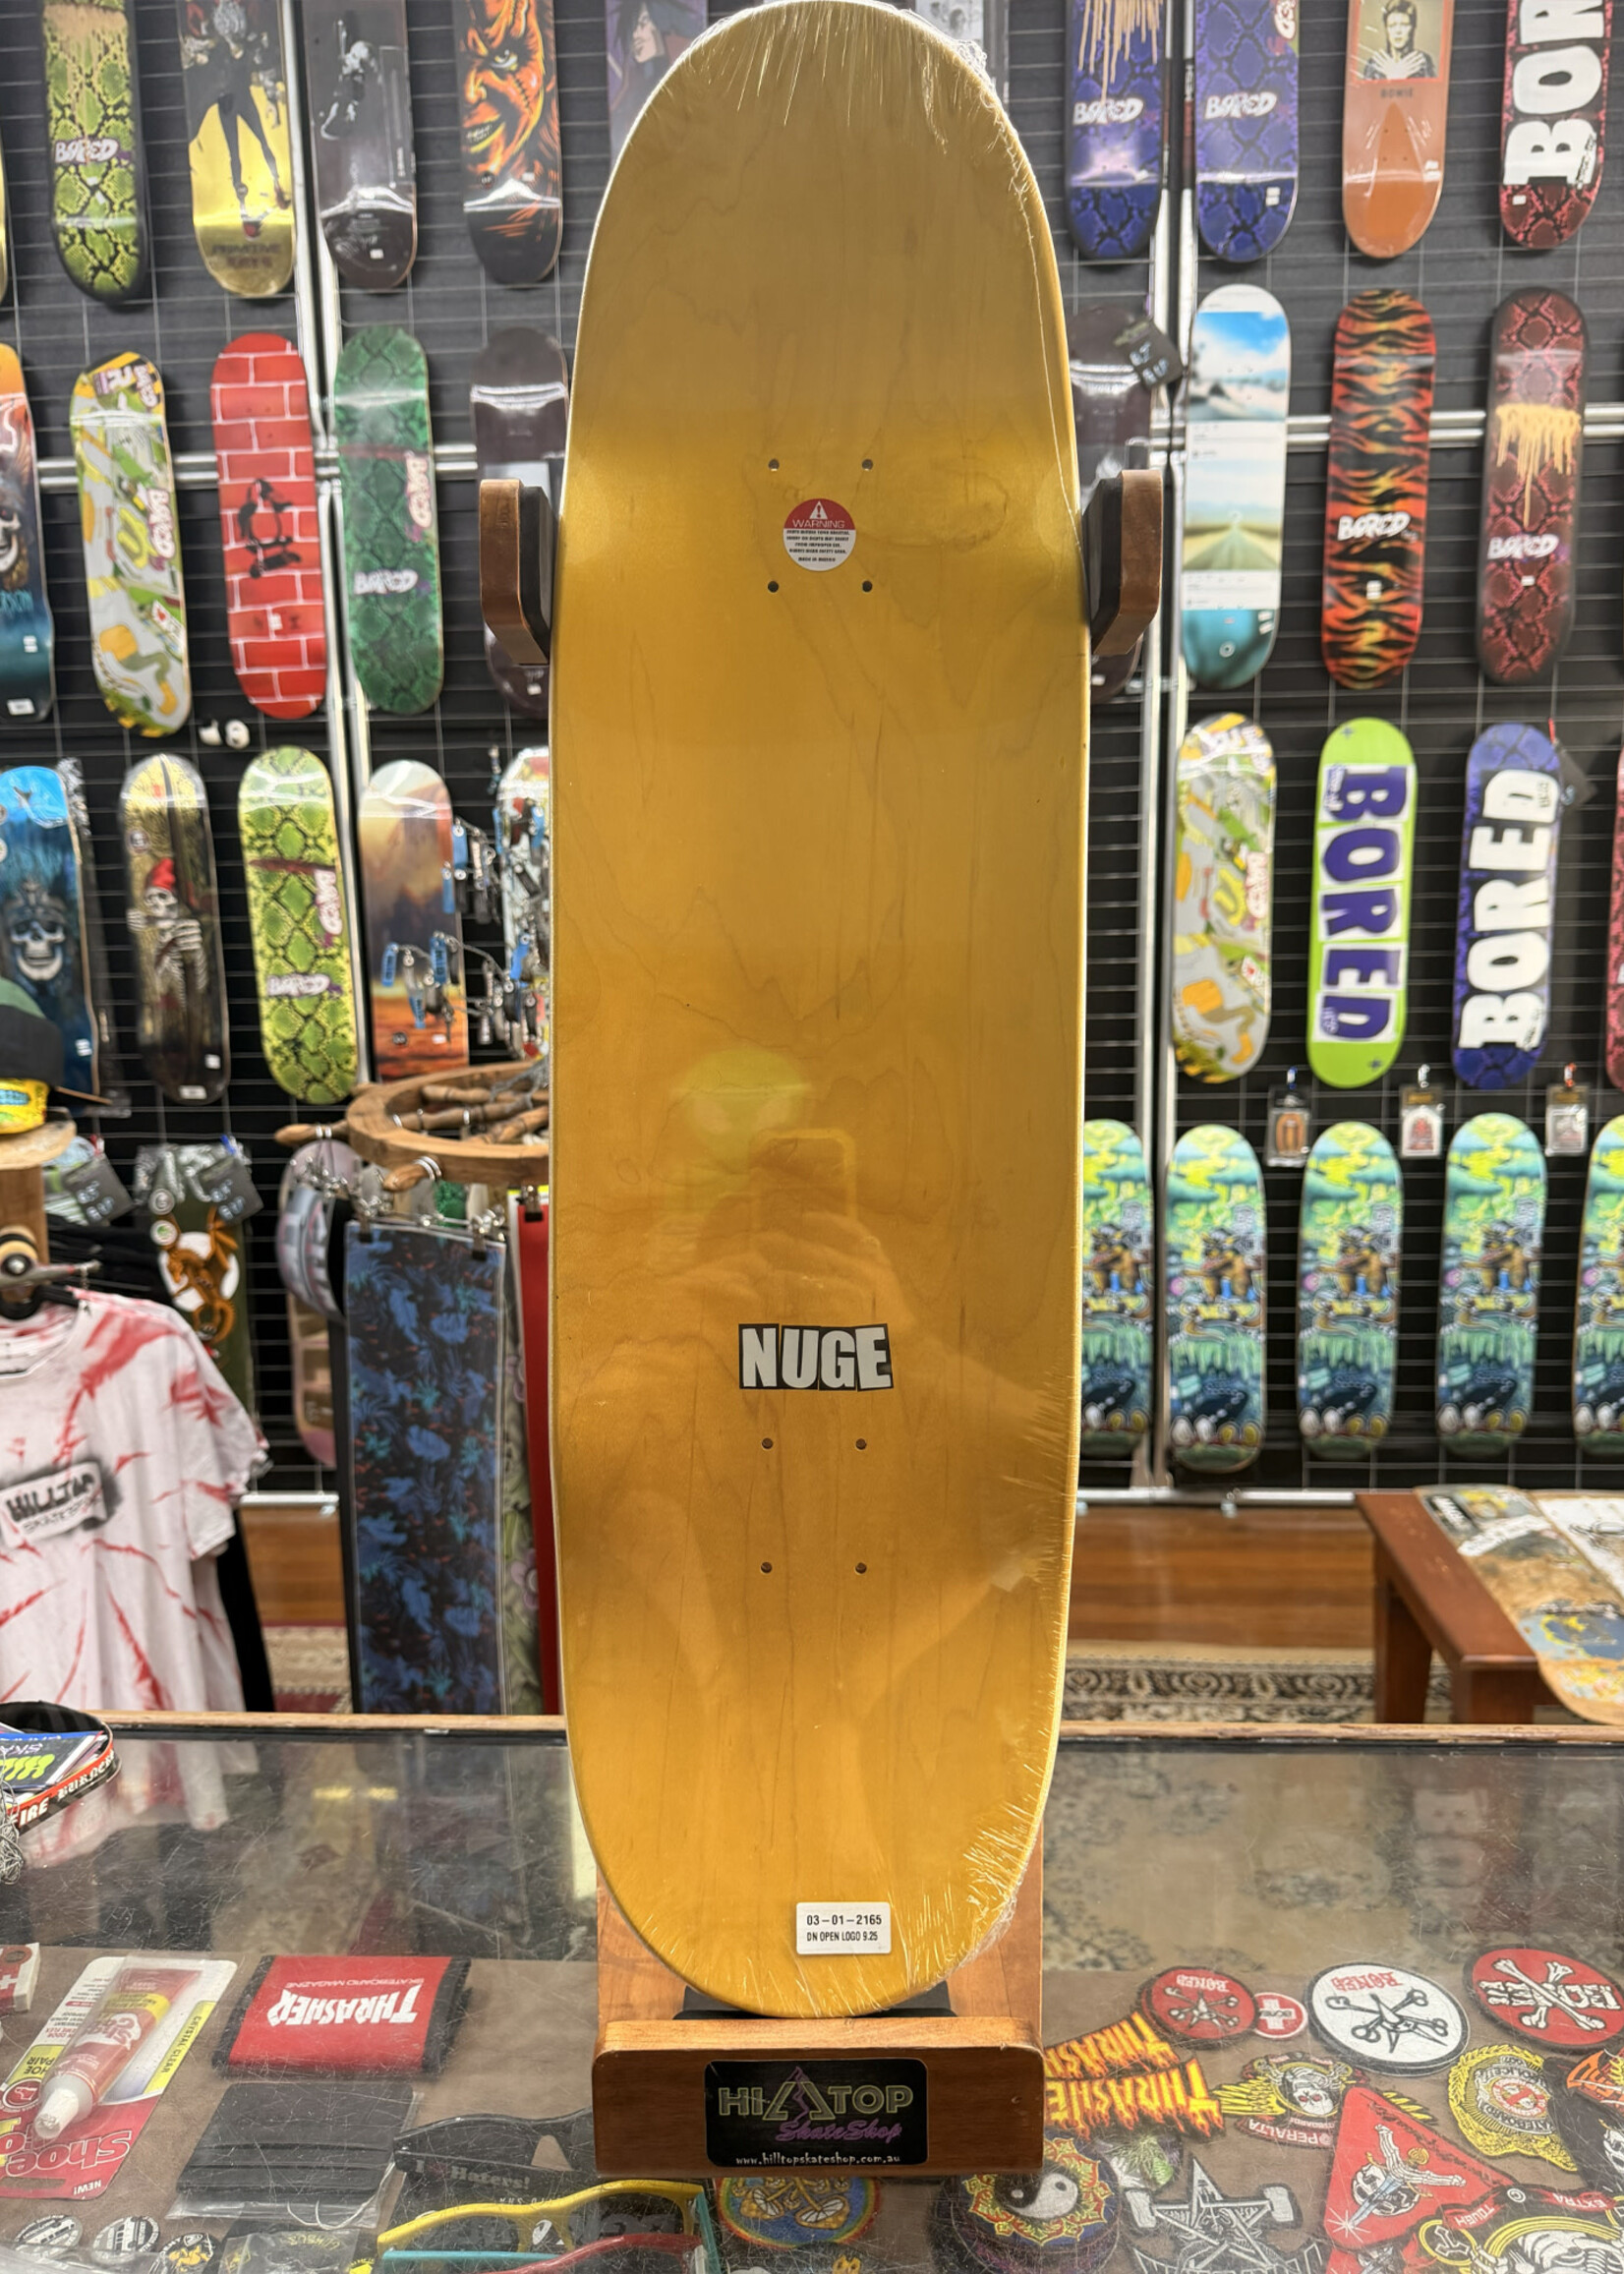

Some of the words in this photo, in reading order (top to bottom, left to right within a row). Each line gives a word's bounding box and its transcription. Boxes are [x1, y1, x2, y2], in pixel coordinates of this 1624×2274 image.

[792, 519, 845, 529] WARNING
[1322, 767, 1407, 1039] BORED
[1459, 769, 1560, 1049] BORED
[740, 1326, 892, 1390] NUGE
[806, 1932, 818, 1942] DN
[819, 1931, 840, 1942] OPEN
[841, 1931, 861, 1942] LOGO
[863, 1930, 878, 1941] 9.25
[266, 1984, 423, 2027] THRASHER
[1248, 2118, 1322, 2145] PERALTA
[5, 2129, 133, 2178] Shoe
[735, 2151, 901, 2167] www.hilltopskateshop.com.au
[73, 2179, 102, 2195] NEW!
[1551, 2192, 1608, 2210] EXTRA
[1454, 2203, 1496, 2227] TOUGH
